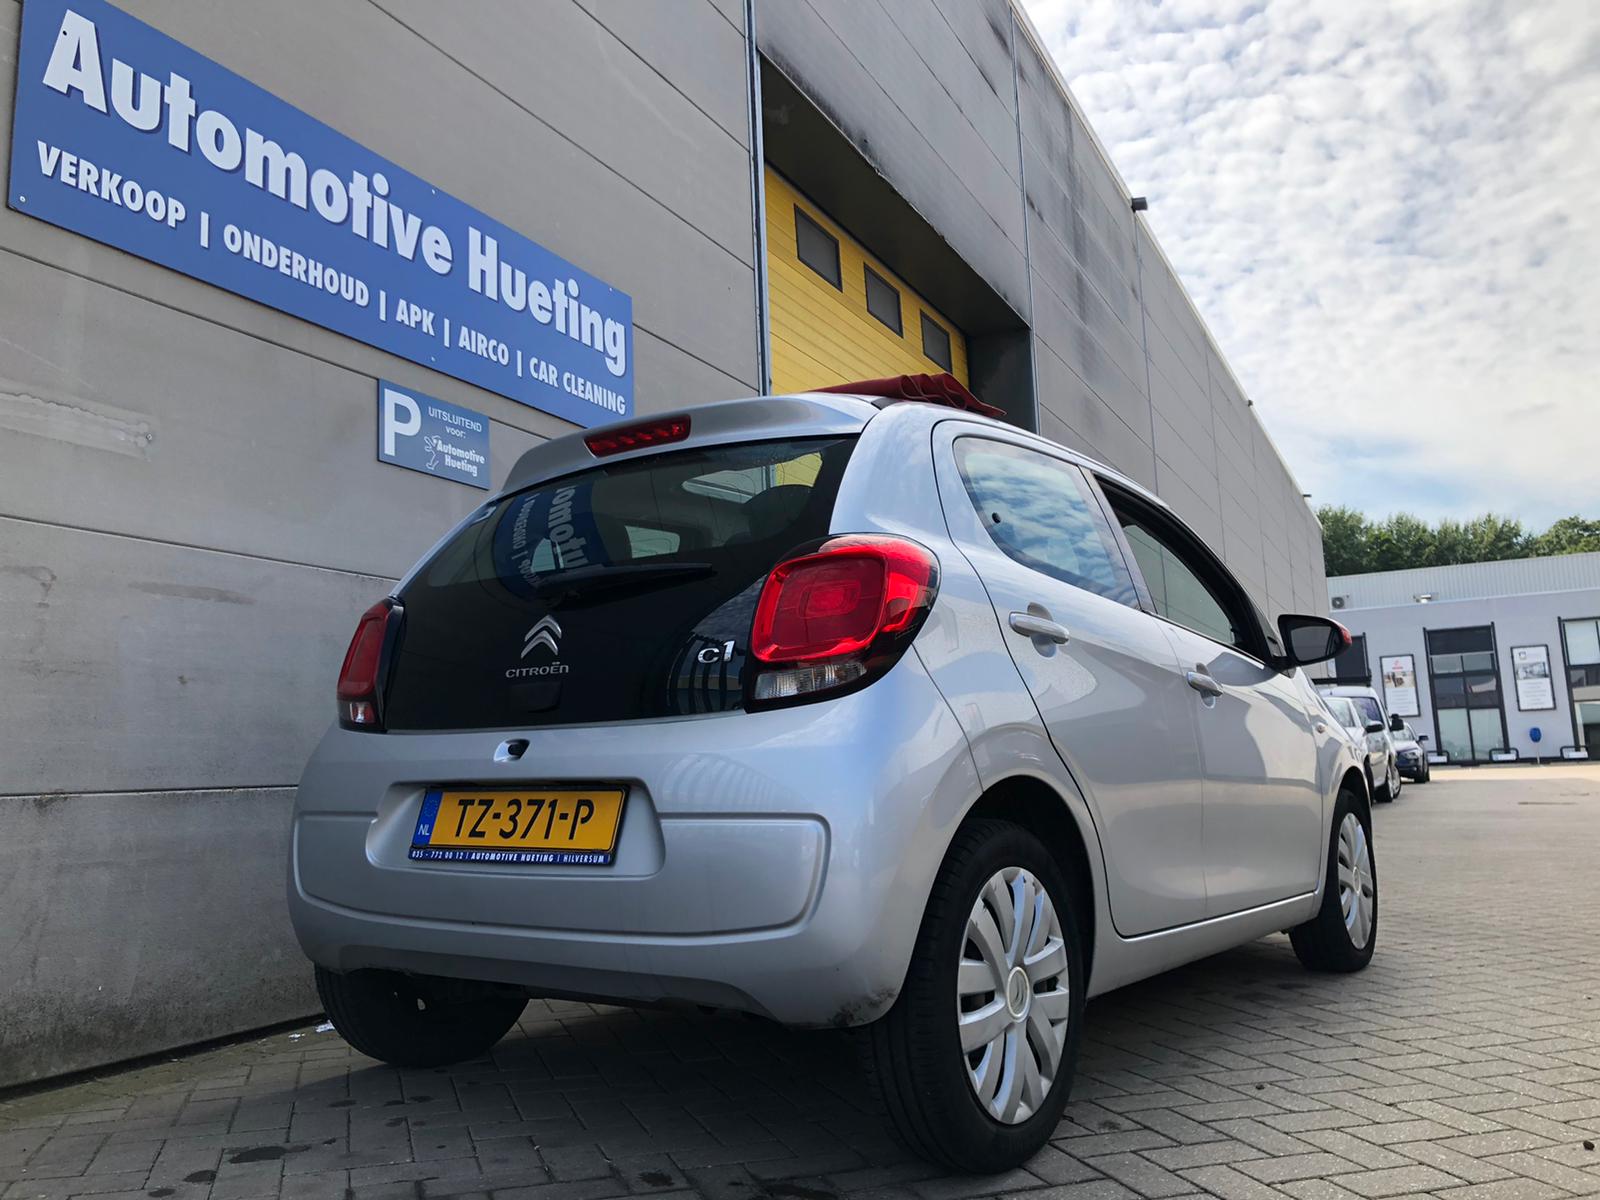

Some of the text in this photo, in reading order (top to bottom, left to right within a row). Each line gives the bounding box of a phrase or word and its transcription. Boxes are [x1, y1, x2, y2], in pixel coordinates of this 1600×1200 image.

[42, 9, 626, 376] Automotive Hueting
[37, 140, 187, 228] VERKOOP
[223, 224, 370, 307] ONDERHOUD
[395, 298, 436, 337] APK
[458, 326, 510, 366] AIRCO
[529, 357, 559, 388] CAR
[562, 372, 626, 415] CLEANING
[384, 388, 422, 456] P
[428, 406, 483, 433] UITSLUITEND
[436, 439, 486, 464] Automotive
[444, 454, 478, 477] Hueting
[418, 823, 431, 837] NL
[455, 798, 595, 841] TZ-371-P
[471, 852, 518, 862] AUTOMOTIVE
[520, 853, 554, 862] HUETING
[563, 854, 605, 864] HILVERSUM
